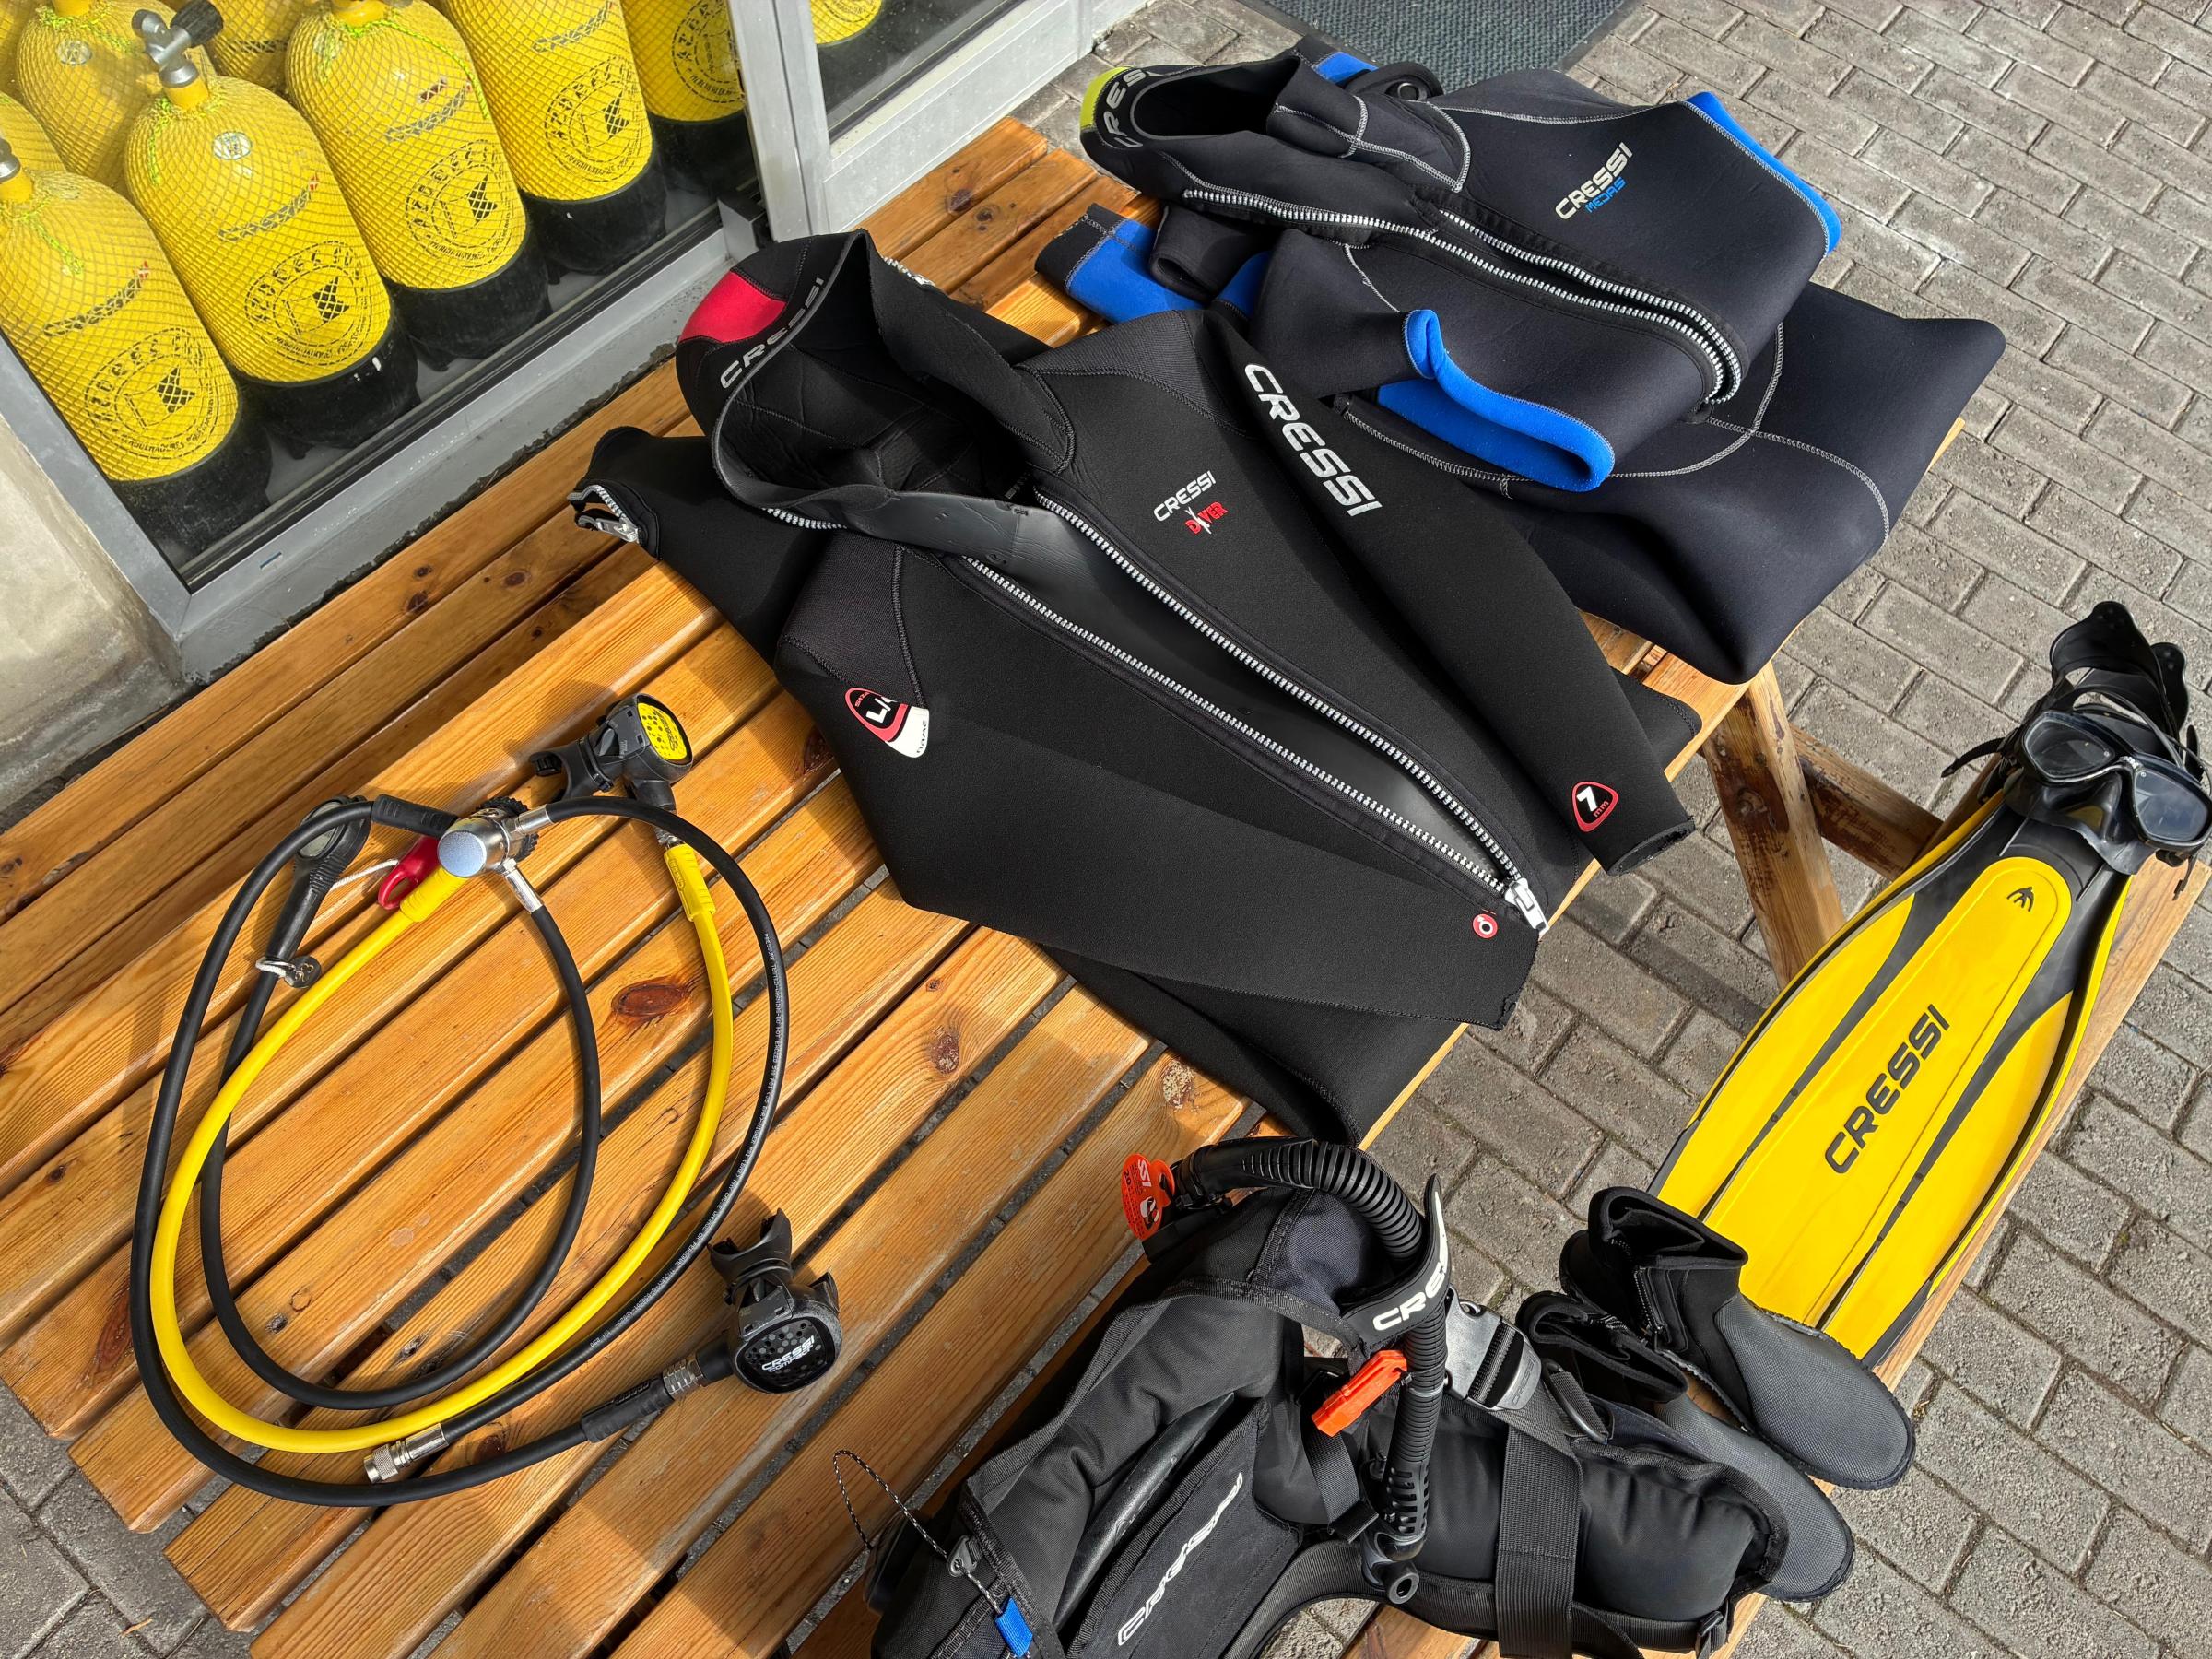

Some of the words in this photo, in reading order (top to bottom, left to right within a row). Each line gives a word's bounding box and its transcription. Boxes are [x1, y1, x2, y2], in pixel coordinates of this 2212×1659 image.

[1555, 142, 1633, 219] CRESSI
[1584, 176, 1627, 213] MEDAS
[720, 277, 825, 388] CRESSI
[1244, 364, 1382, 516] CRESSI
[1153, 470, 1217, 522] CRESSI
[1184, 501, 1229, 535] DIVER
[1576, 786, 1597, 812] 7
[1825, 1004, 1950, 1174] CRESSI
[761, 1335, 815, 1371] CRESSI
